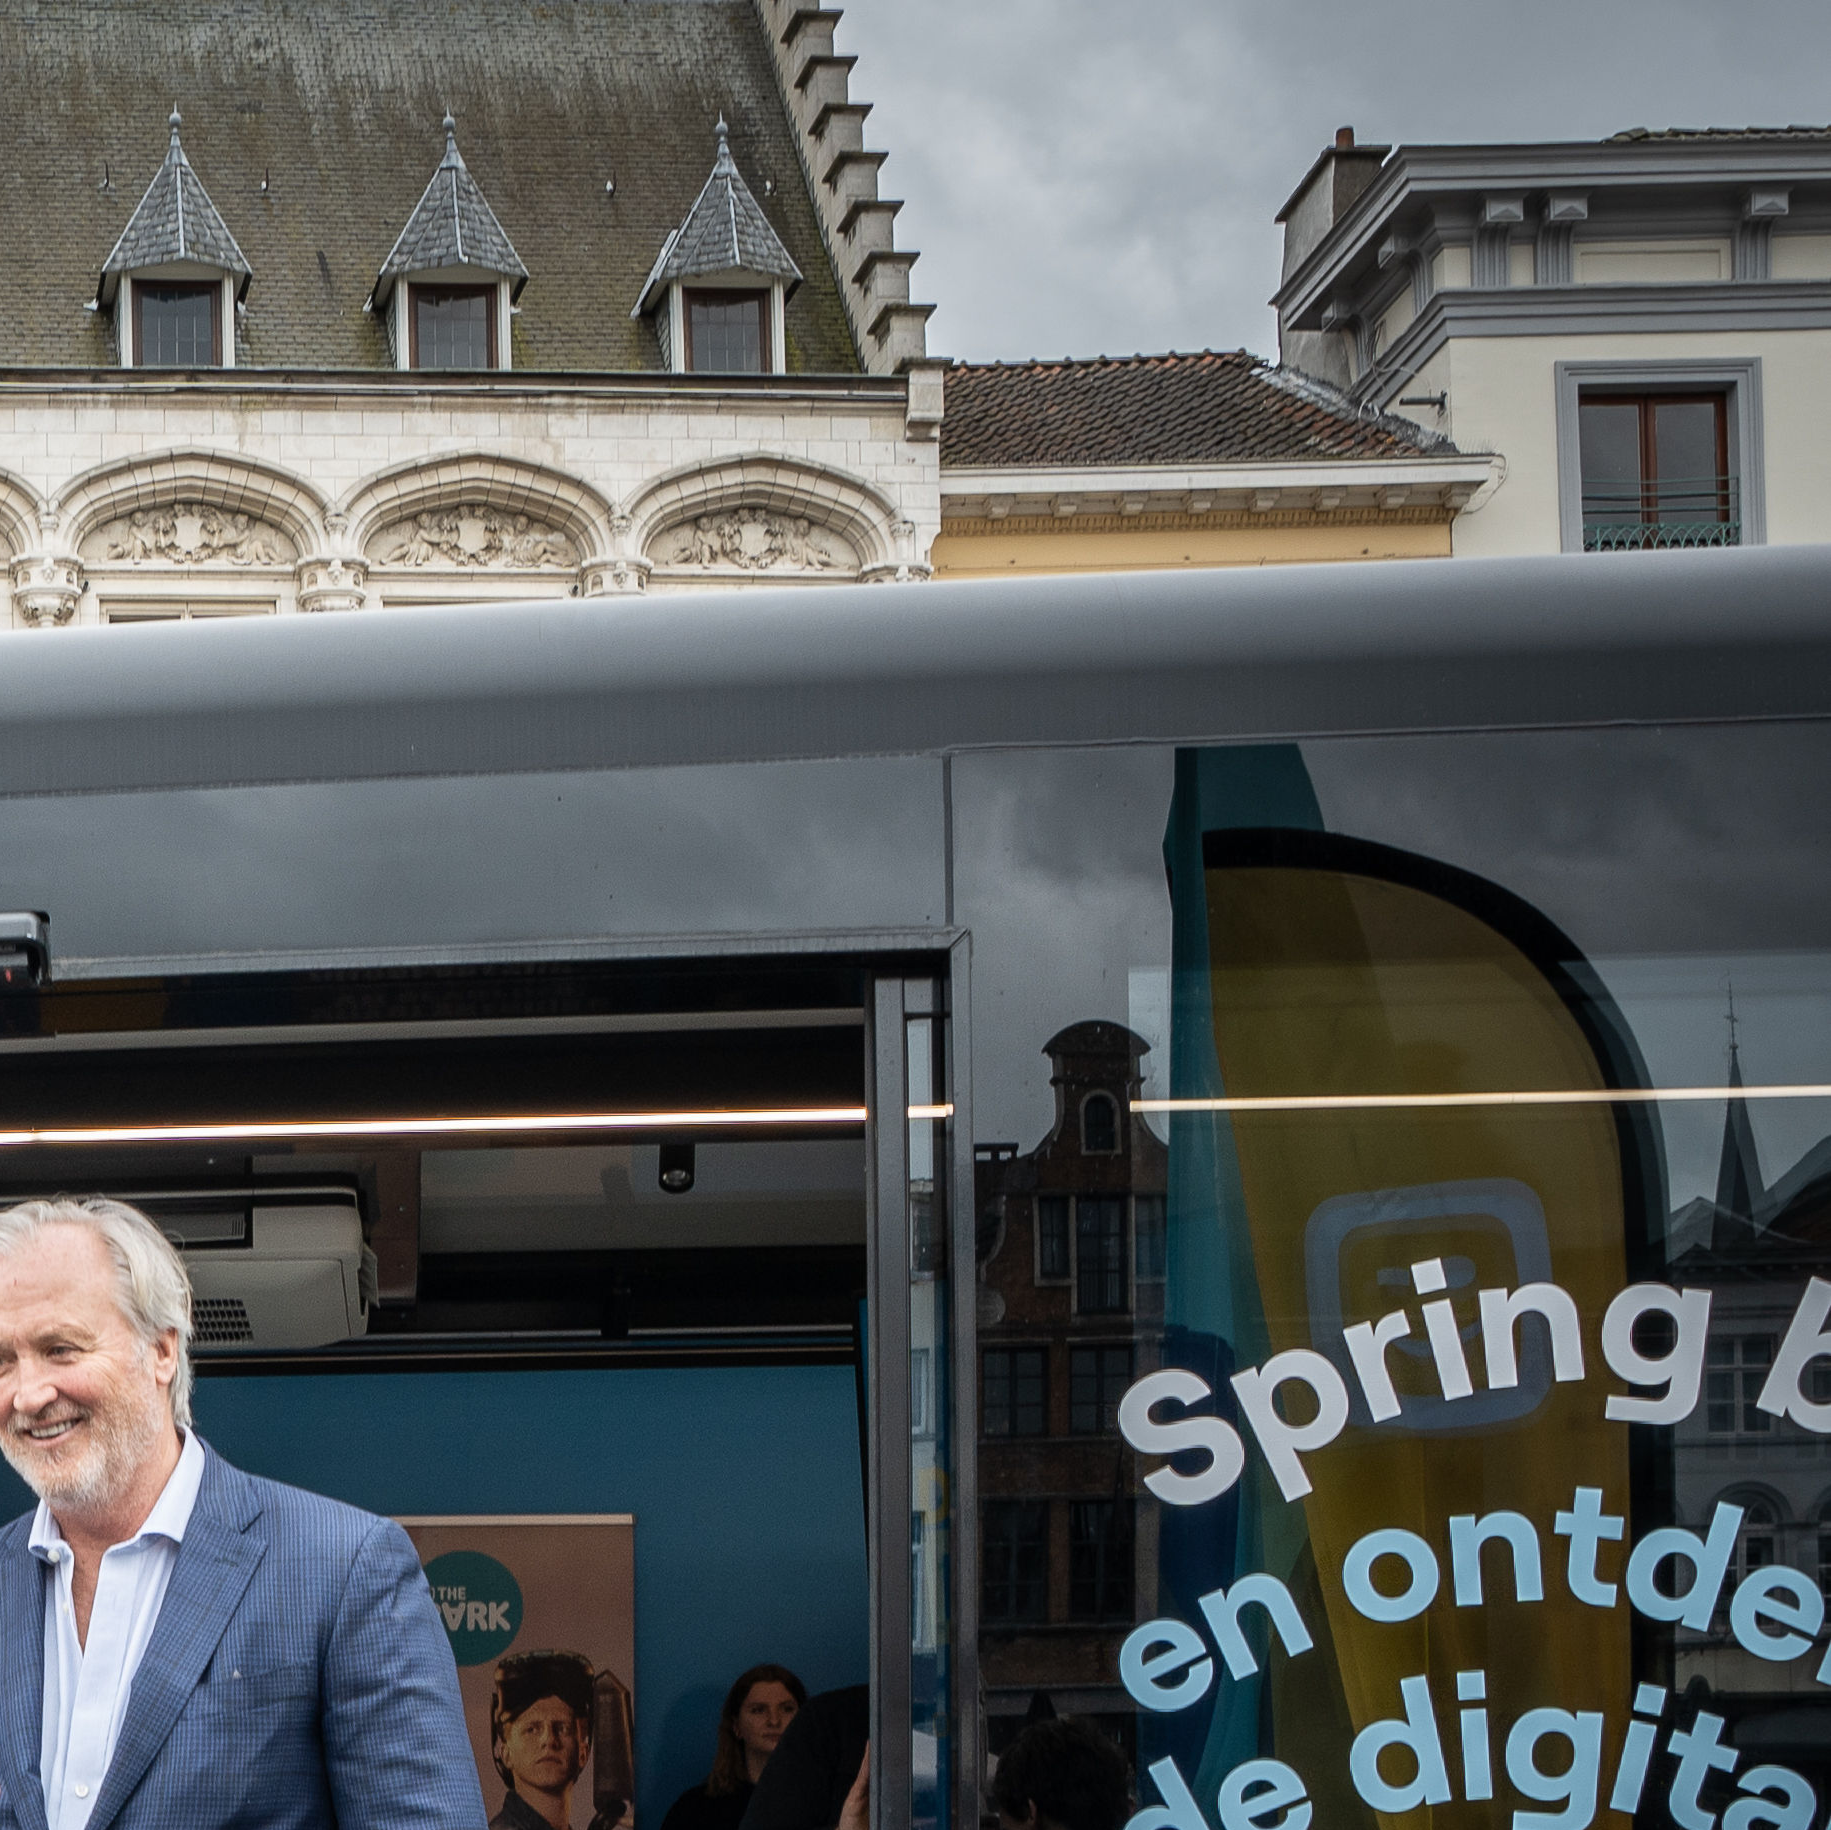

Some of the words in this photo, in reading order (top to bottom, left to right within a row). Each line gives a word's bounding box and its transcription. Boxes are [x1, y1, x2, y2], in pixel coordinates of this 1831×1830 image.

[1118, 1258, 1712, 1505] Spring
[437, 1586, 467, 1601] THE
[1118, 1573, 1314, 1713] en
